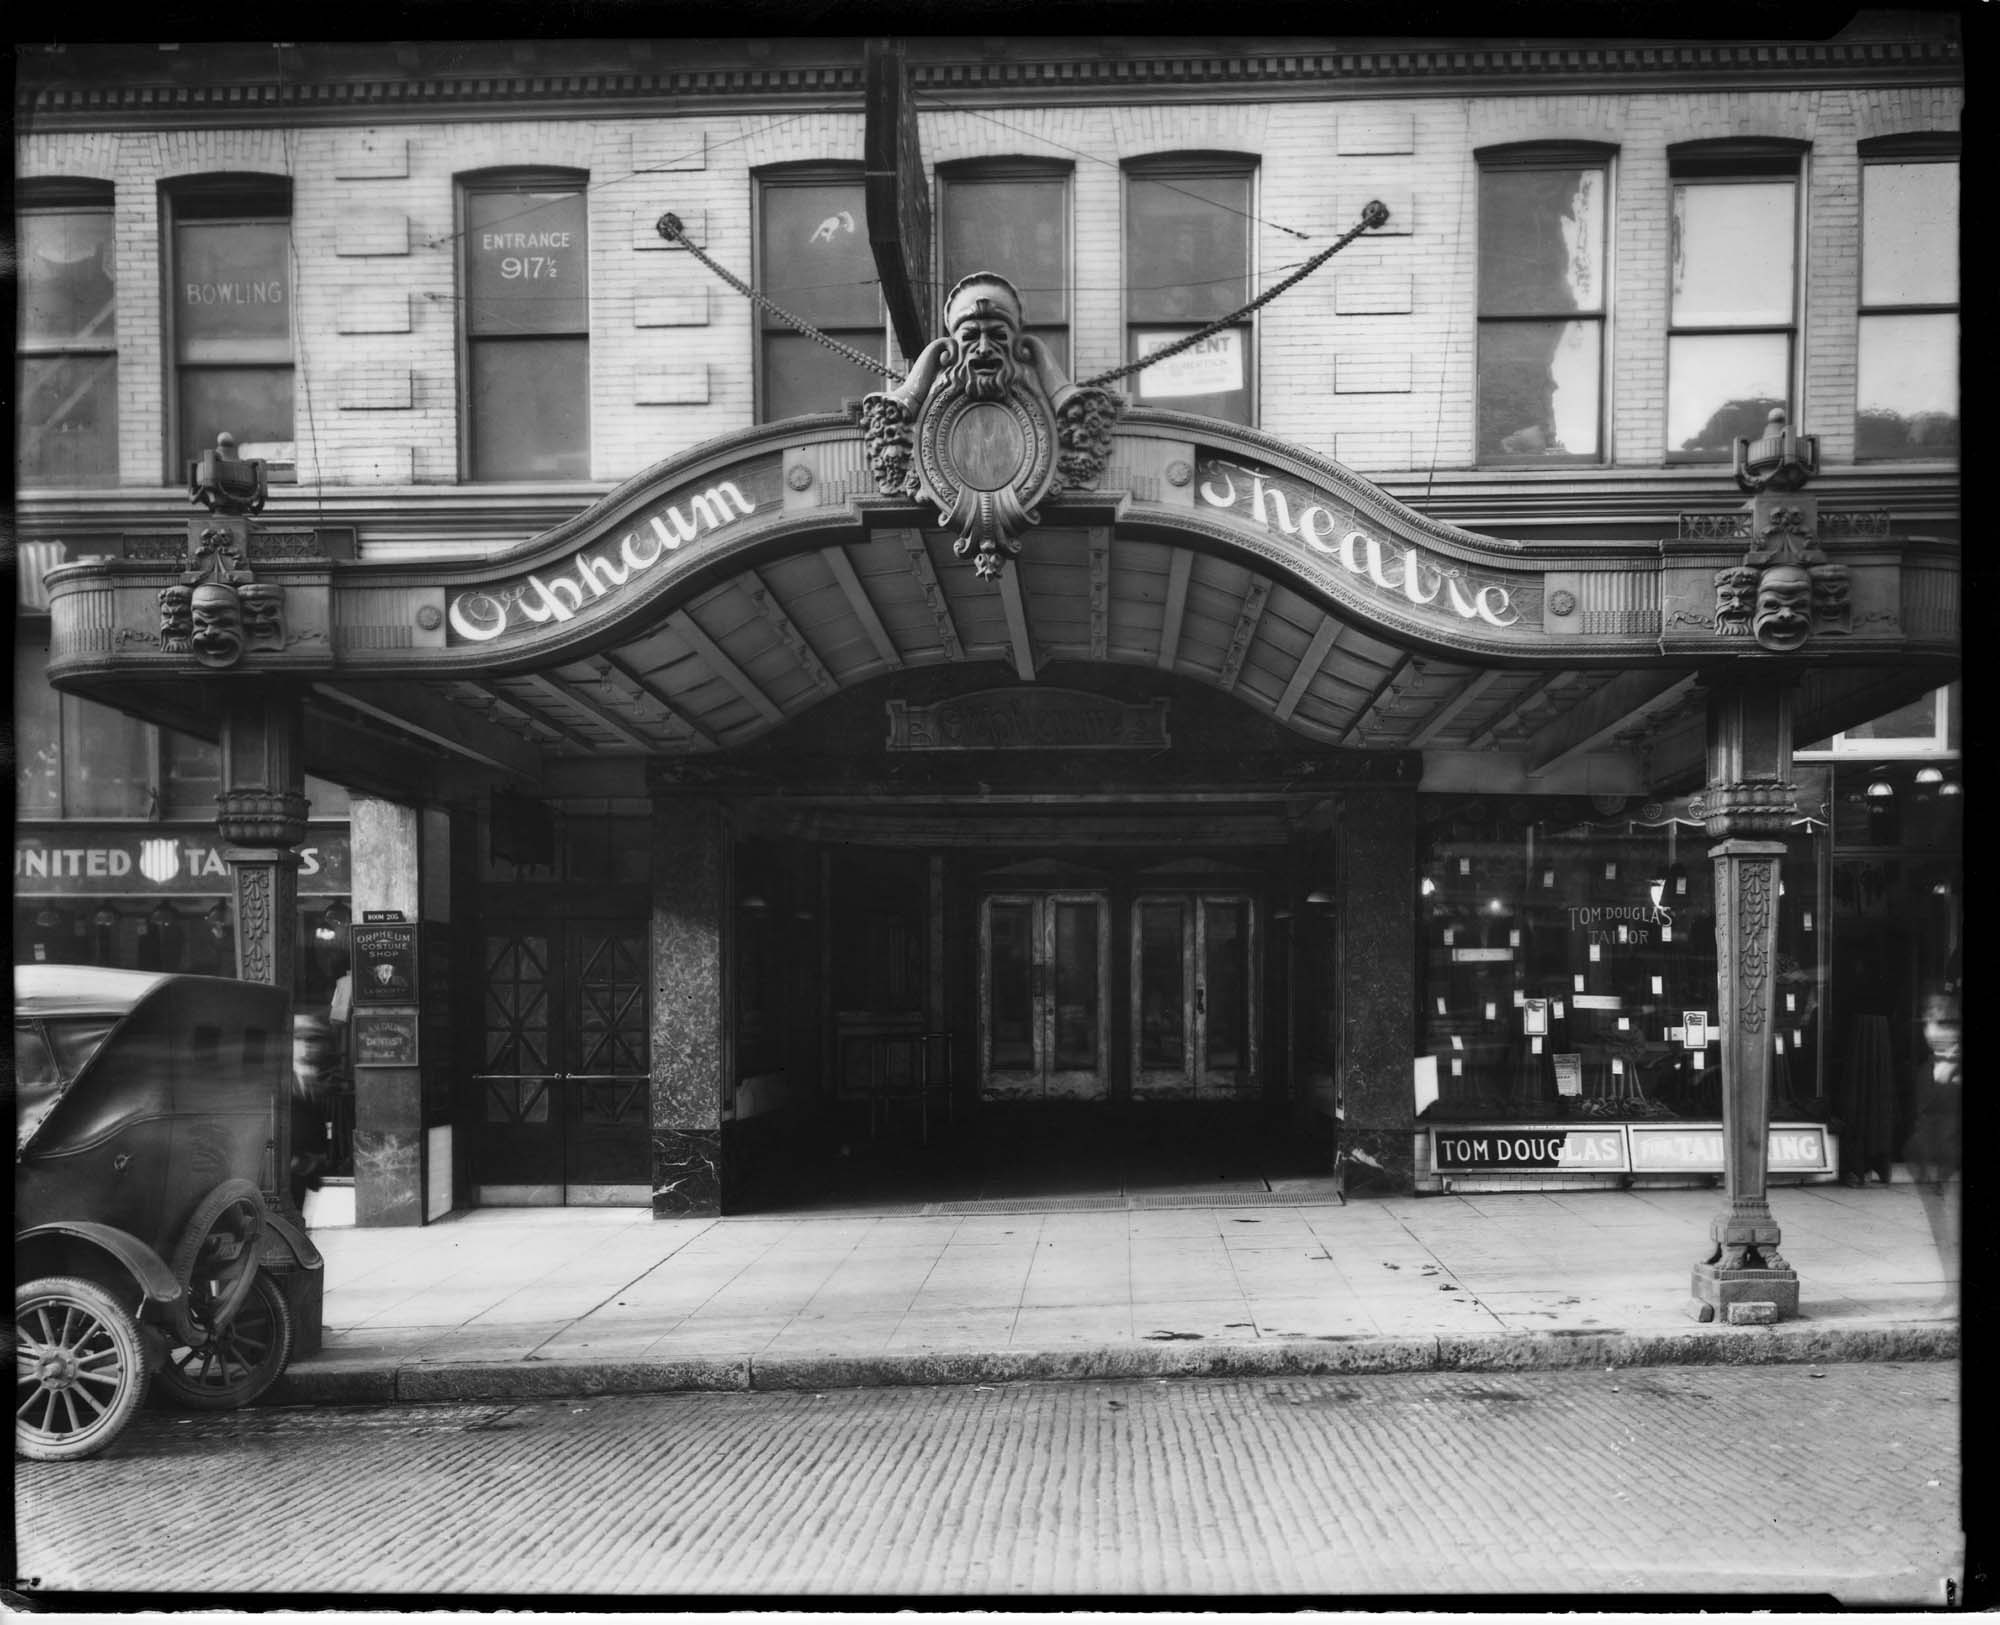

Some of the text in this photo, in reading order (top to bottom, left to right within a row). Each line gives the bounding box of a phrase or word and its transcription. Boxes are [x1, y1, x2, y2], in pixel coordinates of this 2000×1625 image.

[482, 232, 570, 250] ENTRANCE
[186, 281, 282, 305] BOWLING
[1182, 336, 1231, 357] ENT
[450, 459, 1520, 641] Orpheum Theatre
[367, 913, 384, 921] ROOM
[1568, 906, 1673, 931] TOM DOUGLAS
[356, 930, 410, 943] ORPHEUM
[1588, 930, 1649, 945] TAIOR
[1441, 1139, 1490, 1161] TOM
[1498, 1139, 1619, 1161] DOUGLAS
